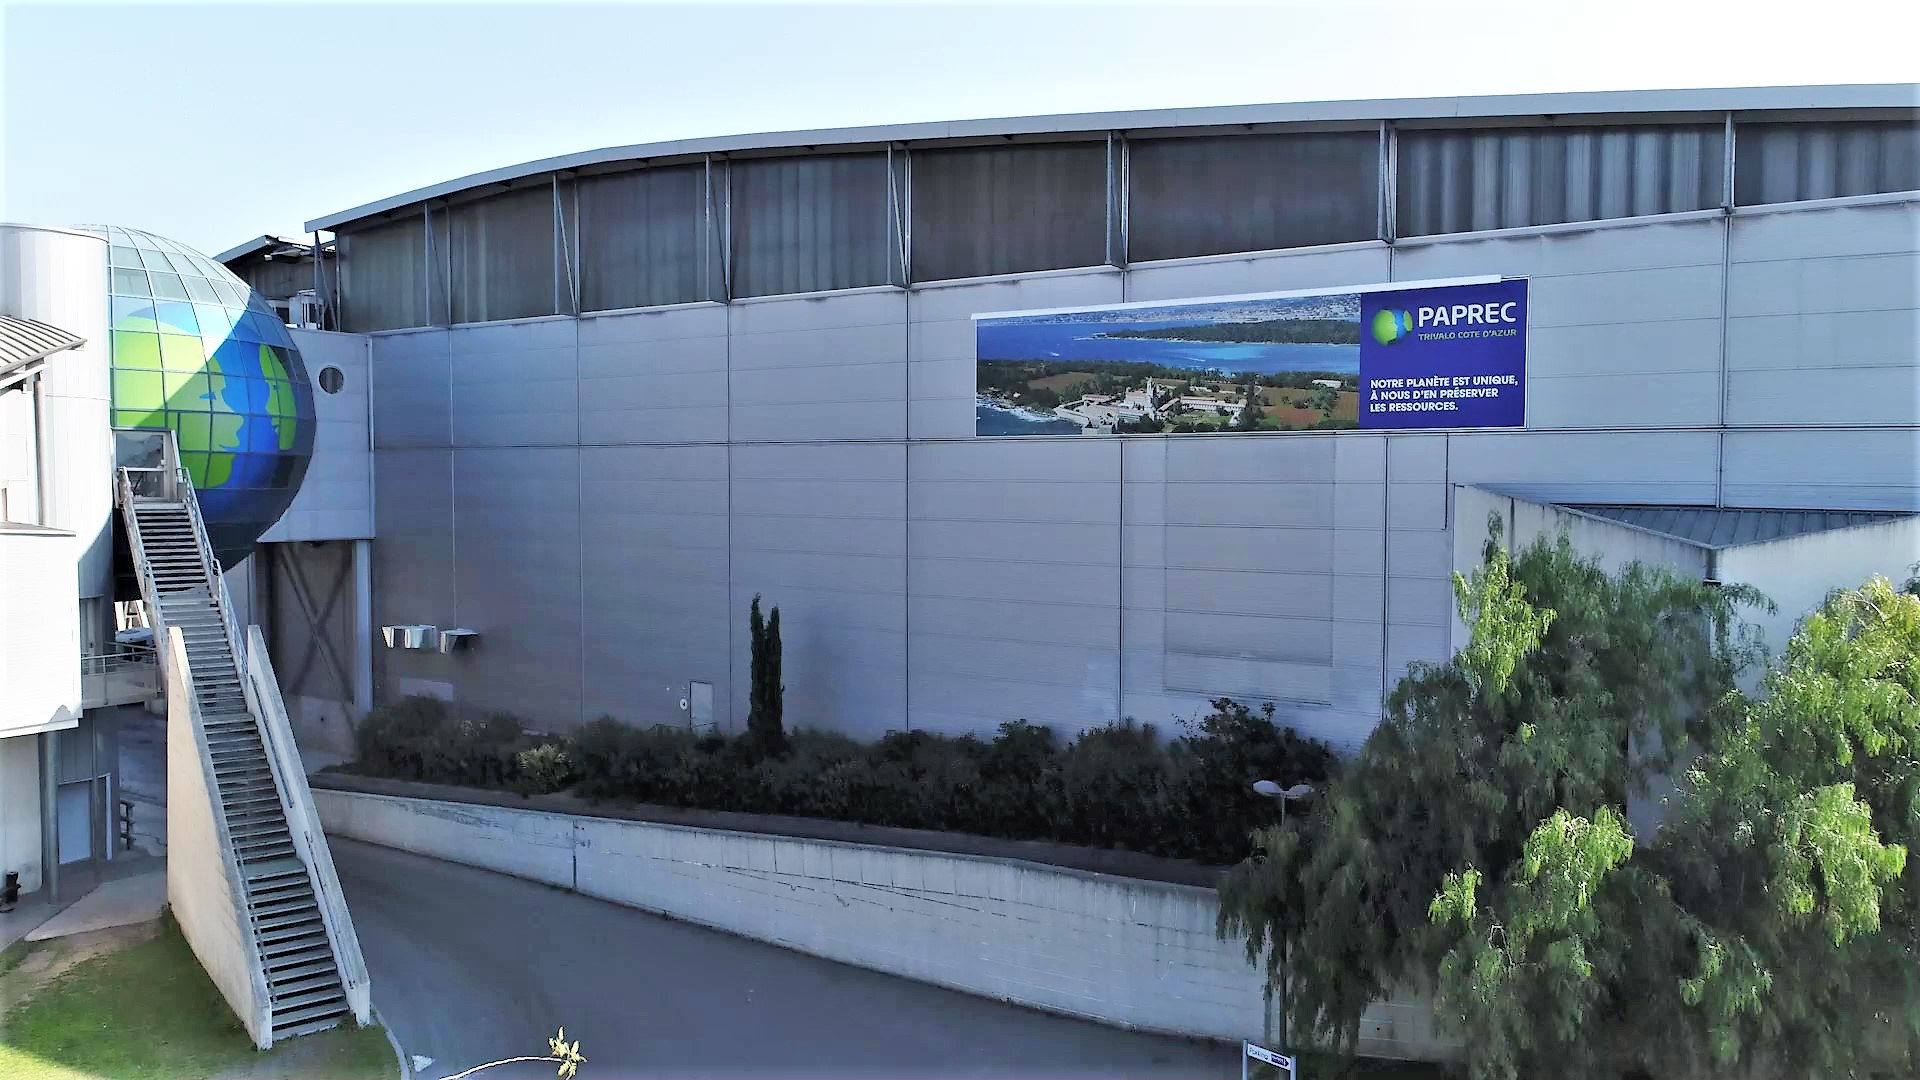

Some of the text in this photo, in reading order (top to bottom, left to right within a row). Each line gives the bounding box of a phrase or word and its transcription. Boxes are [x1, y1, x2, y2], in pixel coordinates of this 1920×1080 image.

[1418, 302, 1517, 327] PAPREC
[1418, 333, 1456, 341] TRIVALO
[1482, 329, 1517, 338] D'AZUR
[1370, 374, 1518, 389] NOTRE PLANÈTE EST UNIQUE,
[1370, 387, 1498, 400] À NOUS D'EN PRÉSERVER
[1370, 401, 1459, 412] LES RESSOURCES.
